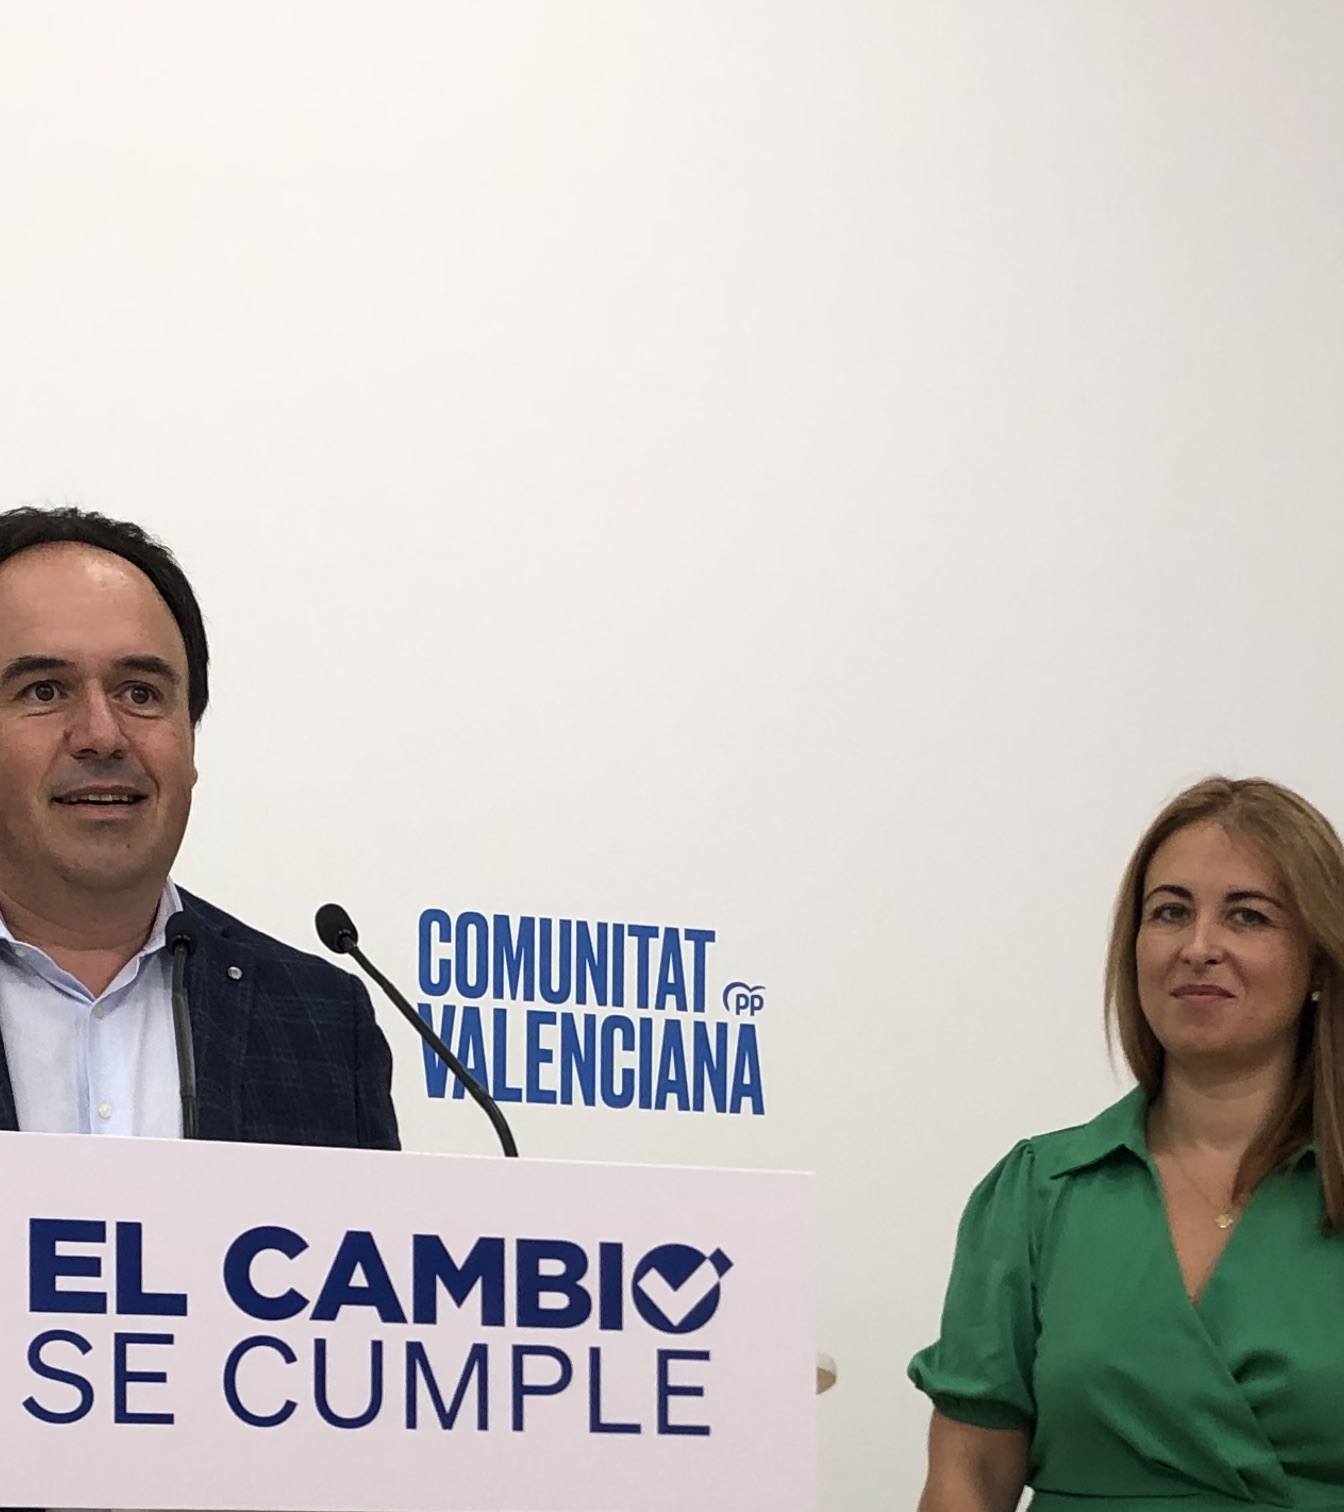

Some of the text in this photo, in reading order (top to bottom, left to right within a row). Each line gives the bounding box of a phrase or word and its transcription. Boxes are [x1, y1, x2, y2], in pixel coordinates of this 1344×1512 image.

[417, 908, 716, 1013] COMUNITAT
[416, 1002, 766, 1115] VALENCIANA
[29, 1218, 188, 1317] EL
[22, 1330, 712, 1437] SE CUMPLE
